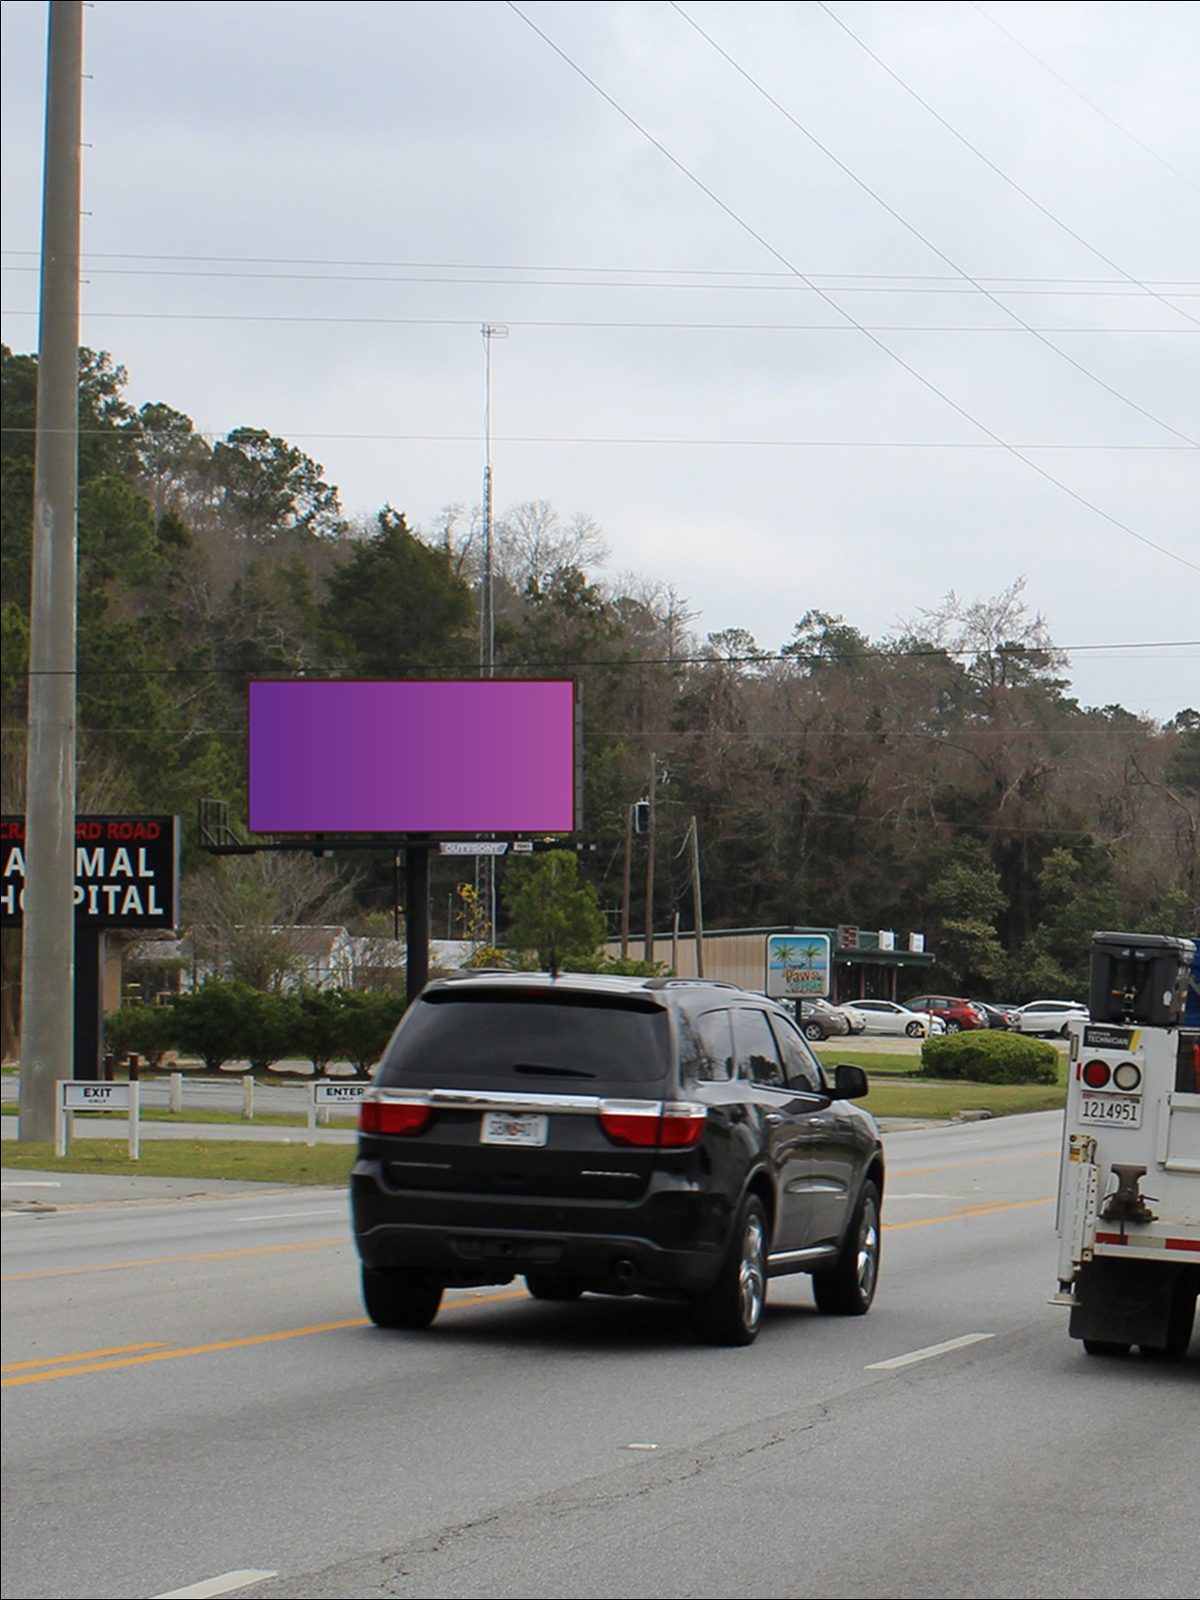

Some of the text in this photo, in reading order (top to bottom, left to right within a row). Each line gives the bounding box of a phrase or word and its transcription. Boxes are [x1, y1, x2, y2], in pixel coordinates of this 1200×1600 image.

[106, 822, 161, 840] ROAD
[3, 847, 155, 877] AMAL
[1, 885, 164, 915] HPITAL
[1087, 1035, 1129, 1046] TECHNICIAN
[83, 1087, 112, 1098] EXIT
[326, 1087, 365, 1096] ENTER
[1082, 1101, 1137, 1121] 1214951
